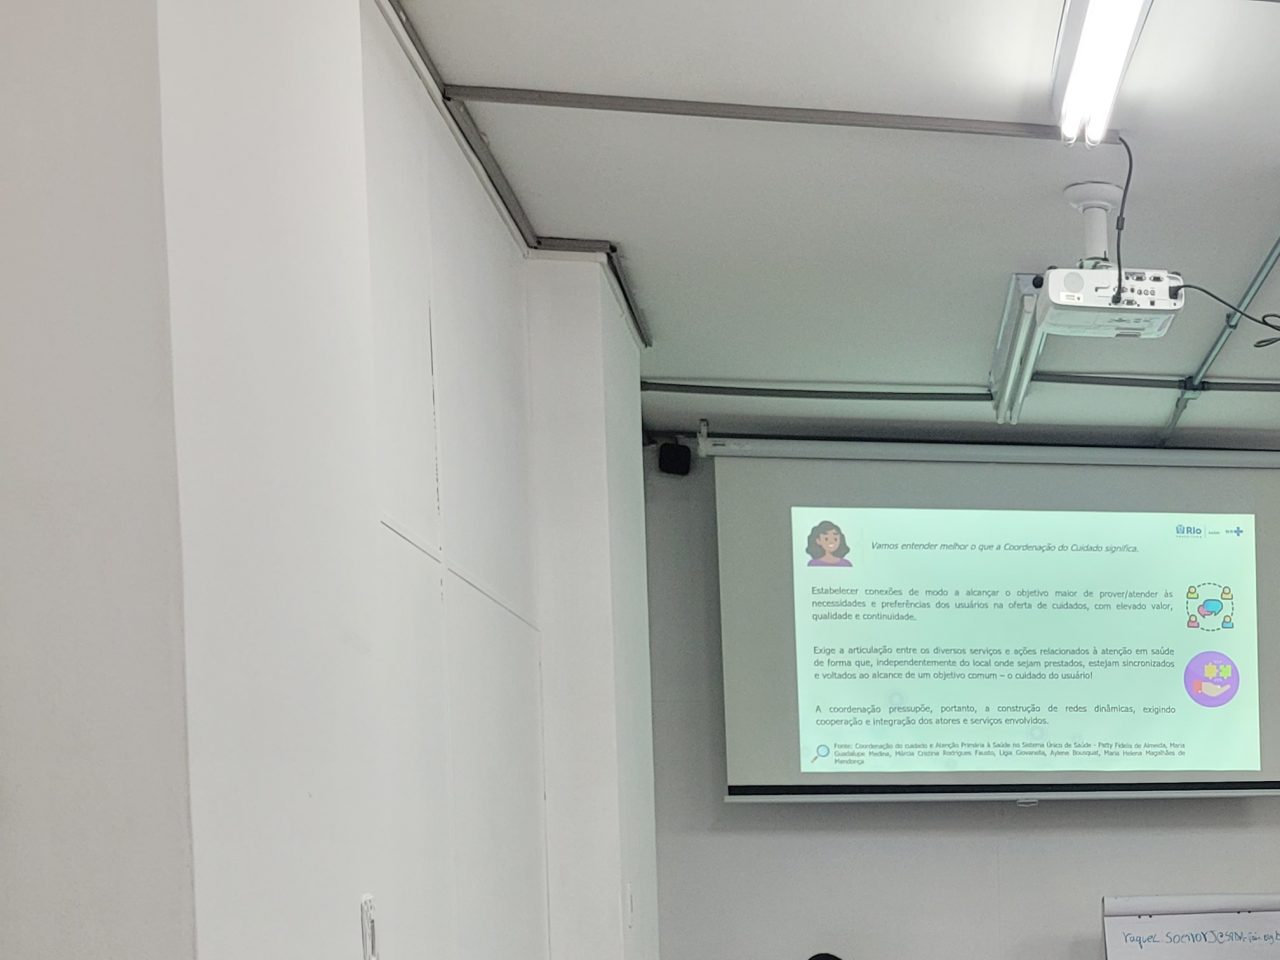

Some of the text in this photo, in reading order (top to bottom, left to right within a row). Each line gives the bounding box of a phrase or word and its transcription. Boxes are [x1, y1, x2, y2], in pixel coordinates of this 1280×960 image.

[872, 542, 899, 550] Vamos
[901, 542, 937, 551] entender
[940, 542, 968, 551] melhor
[1003, 543, 1056, 553] Coordenação
[1058, 543, 1069, 552] do
[1071, 543, 1103, 552] Cuidado
[1105, 544, 1139, 553] significa.
[812, 587, 859, 595] Estabelecer
[865, 587, 903, 596] conexões
[909, 588, 919, 596] de
[925, 588, 948, 596] modo
[966, 588, 999, 598] alcançar
[1017, 589, 1049, 599] objetivo
[1099, 590, 1158, 599] prover/atender
[812, 600, 866, 608] necessidades
[881, 600, 931, 610] preferências
[935, 600, 950, 608] dos
[954, 600, 988, 609] usuários
[1008, 602, 1032, 610] oferta
[1037, 602, 1047, 610] de
[1052, 602, 1089, 611] cuidados,
[1116, 602, 1146, 610] elevado
[1151, 602, 1173, 611] valor,
[812, 612, 852, 621] qualidade
[814, 646, 836, 656] Exige
[848, 645, 892, 656] articulação
[933, 646, 967, 655] diversos
[969, 647, 1001, 656] serviços
[1014, 647, 1037, 657] ações
[1040, 647, 1089, 655] relacionados
[1101, 646, 1132, 657] atenção
[1151, 646, 1174, 655] saúde
[813, 658, 1175, 669] de forma que, independentemente do local onde sejam prestados, estejam sincronizados
[822, 671, 856, 679] voltados
[872, 671, 902, 679] alcance
[905, 671, 915, 679] de
[933, 671, 965, 680] objetivo
[1015, 671, 1046, 680] cuidado
[1049, 671, 1059, 680] do
[1061, 671, 1093, 680] usuário!
[815, 705, 822, 713] A
[829, 704, 881, 714] coordenação
[889, 705, 933, 714] pressupõe,
[941, 705, 977, 714] portanto,
[997, 705, 1041, 714] construção
[1048, 704, 1058, 712] de
[1065, 704, 1087, 712] redes
[1094, 704, 1135, 714] dinâmicas,
[1143, 705, 1176, 715] exigindo
[816, 718, 863, 727] cooperação
[873, 717, 916, 727] integração
[918, 717, 933, 725] dos
[935, 717, 960, 725] atores
[970, 717, 1002, 726] serviços
[1004, 717, 1049, 725] envolvidos.
